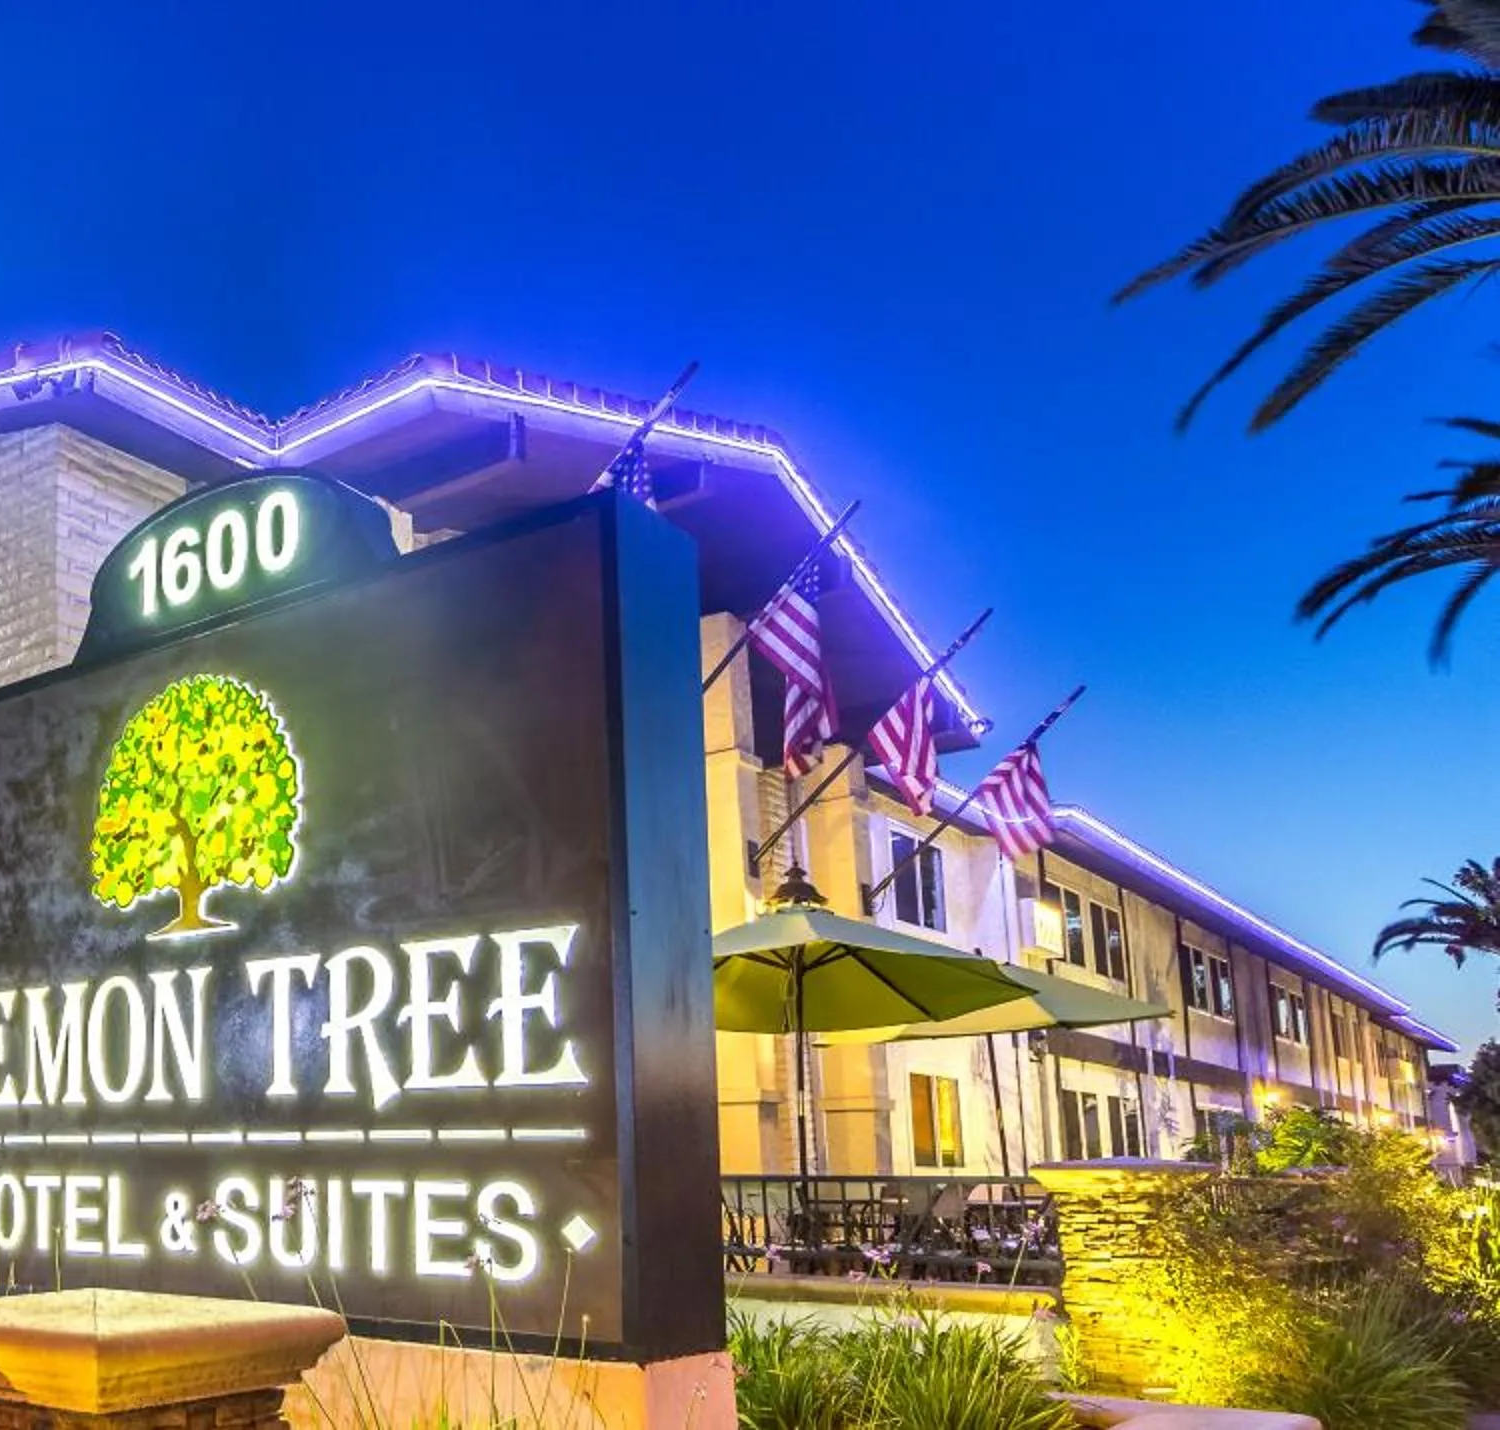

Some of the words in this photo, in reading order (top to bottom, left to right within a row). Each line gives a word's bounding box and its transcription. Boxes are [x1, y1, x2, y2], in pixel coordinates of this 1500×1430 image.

[128, 491, 300, 616] 1600
[246, 924, 590, 1110] TREE
[161, 1191, 197, 1255] &
[213, 1176, 540, 1282] SUITES
